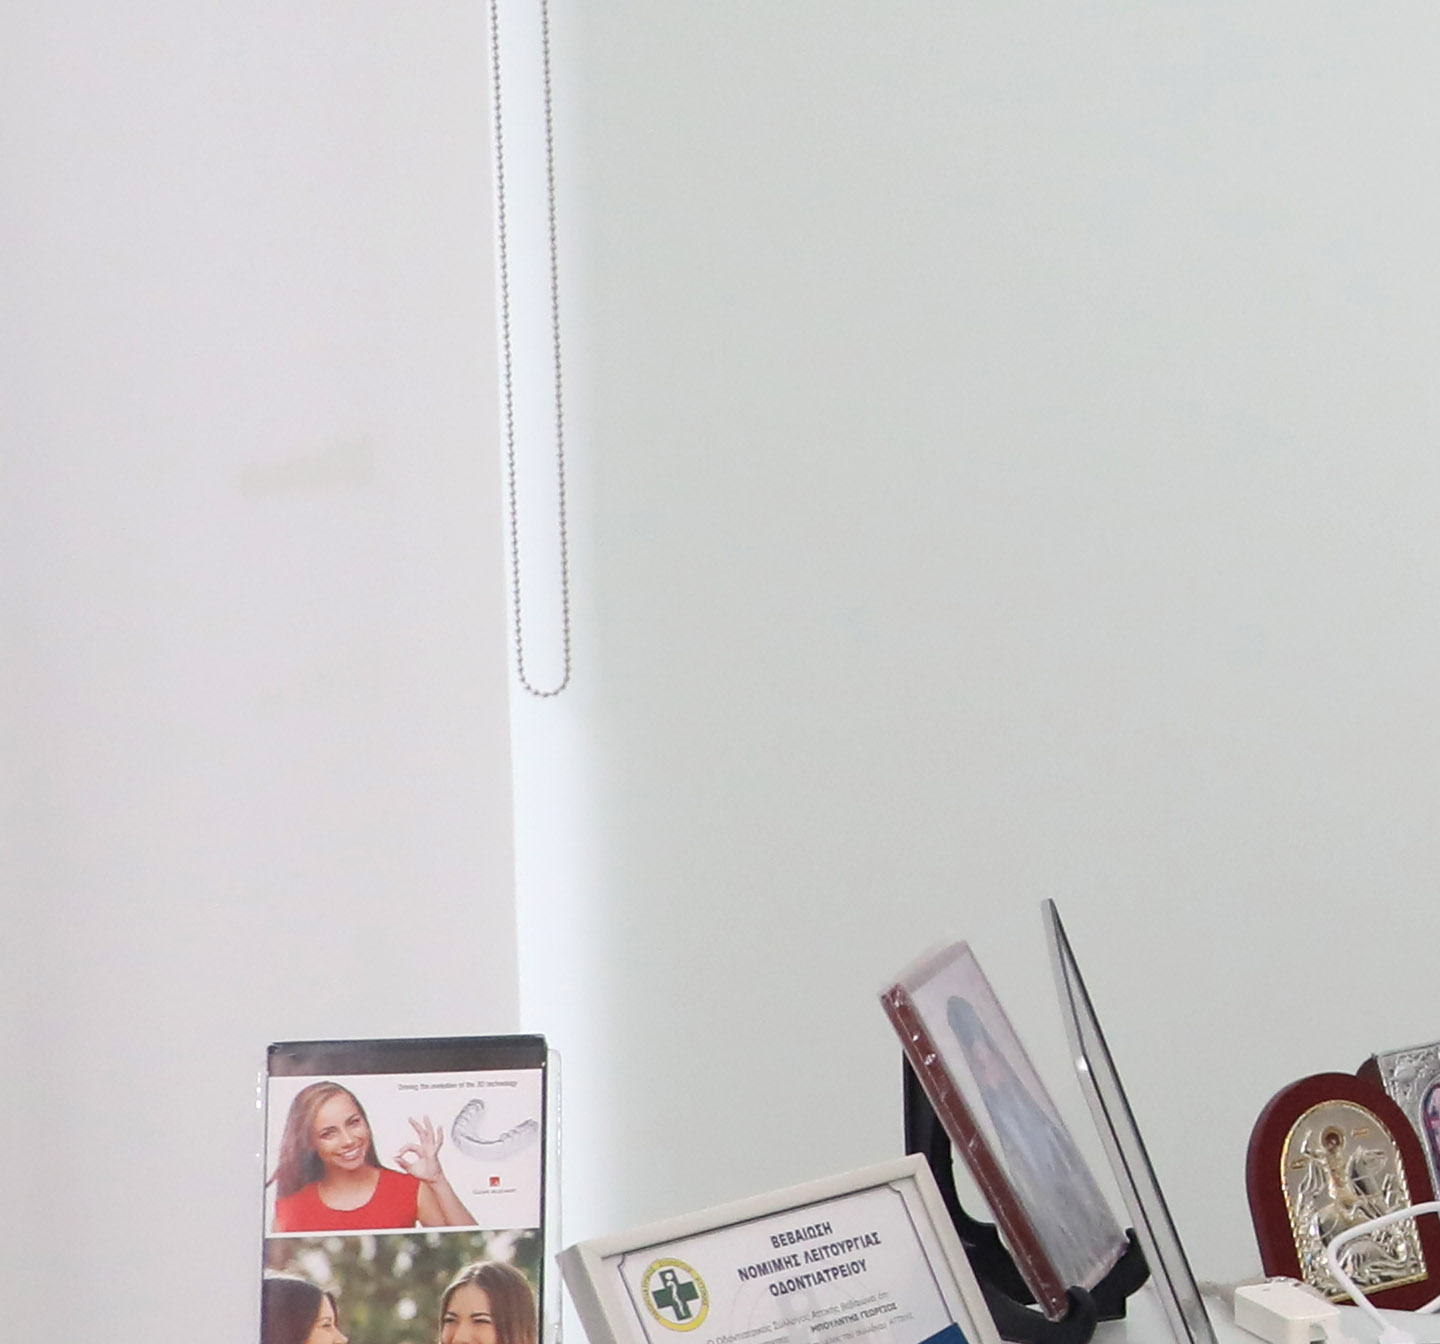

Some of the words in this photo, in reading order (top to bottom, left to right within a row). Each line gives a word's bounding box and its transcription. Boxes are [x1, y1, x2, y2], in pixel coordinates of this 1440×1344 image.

[770, 1221, 833, 1248] ΒΕΒΑΙΩΣΗ
[737, 1254, 801, 1282] ΝΟΜΙΜΗΣ
[804, 1232, 881, 1265] ΛΕΙΤΟΥΡΓΙΑΣ
[769, 1259, 868, 1296] ΟΔΟΝΤΙΑΤΡΕΙΟΥ
